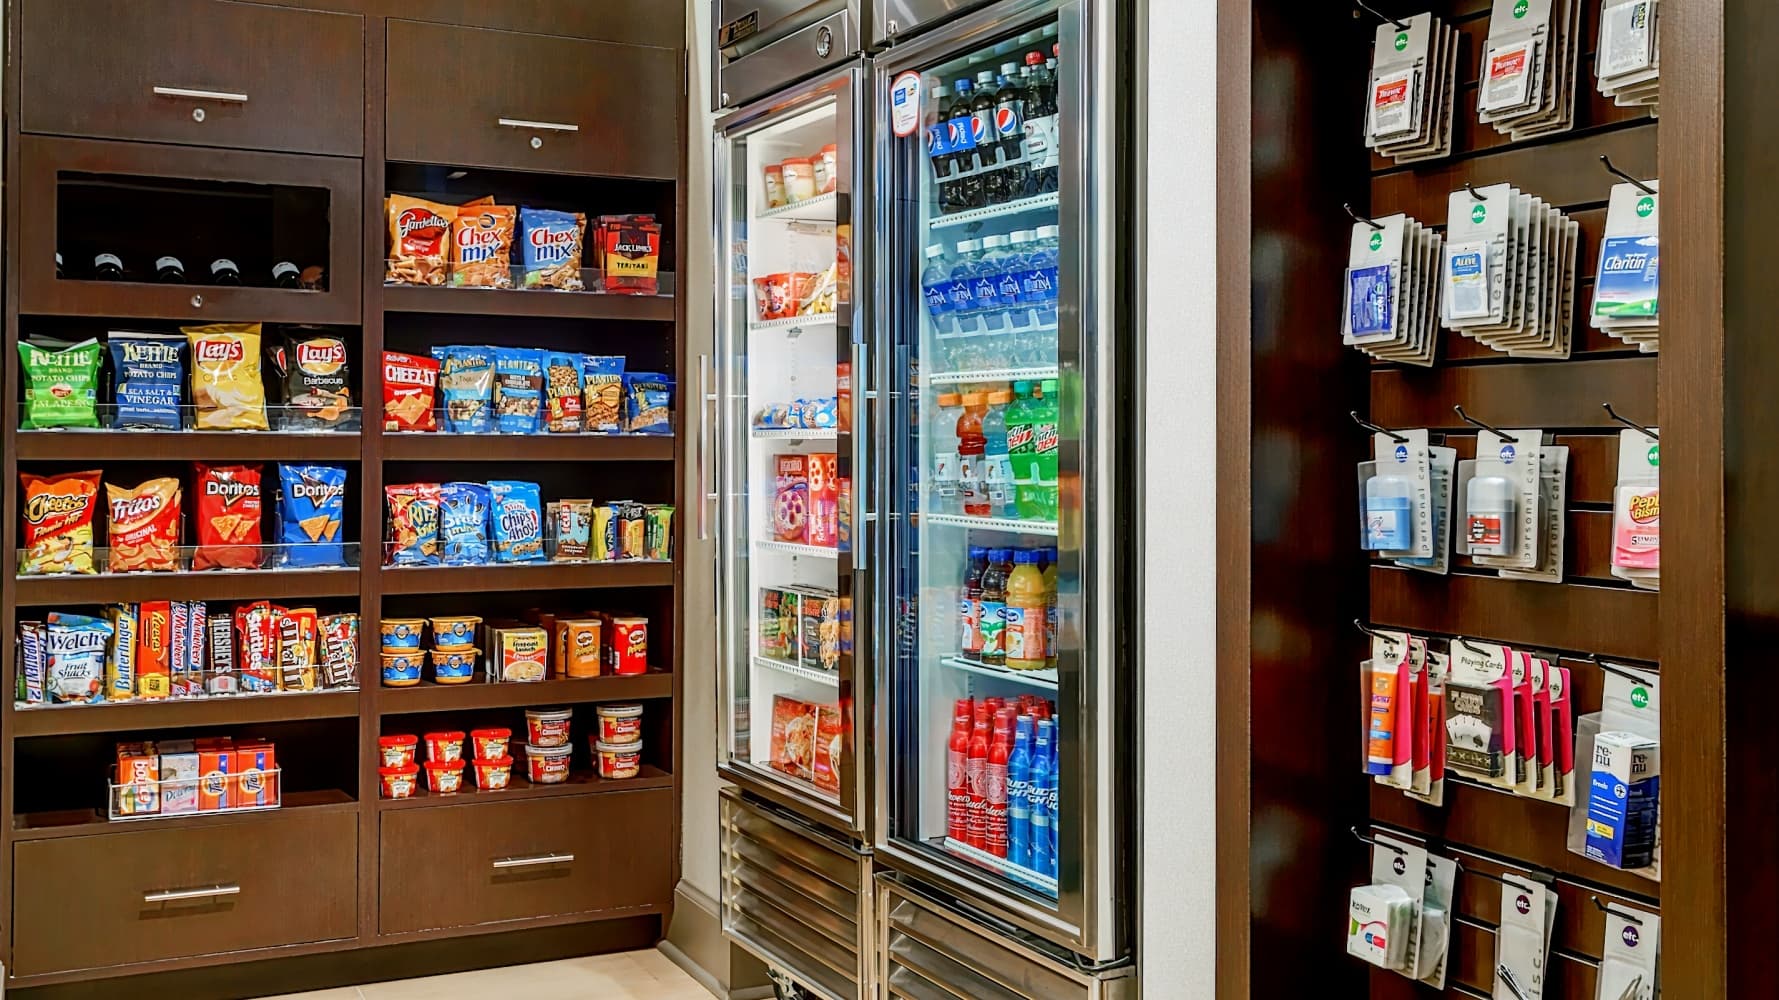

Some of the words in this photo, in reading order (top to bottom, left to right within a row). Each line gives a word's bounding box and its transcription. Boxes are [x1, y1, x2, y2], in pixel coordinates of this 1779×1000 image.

[1637, 202, 1655, 212] etc.
[457, 227, 503, 247] Chex
[530, 228, 577, 246] Chex
[462, 243, 500, 262] mix
[536, 243, 575, 261] mix
[616, 261, 649, 270] TERIYAKI
[1604, 256, 1646, 270] Claritin
[120, 342, 179, 363] KETTLE
[200, 340, 241, 362] Lay's
[301, 341, 342, 363] Lay's
[124, 371, 154, 379] POTATO
[303, 376, 344, 386] Barbecue
[145, 388, 165, 396] SALT
[125, 395, 175, 405] VINEGAR
[206, 481, 260, 496] Doritos
[293, 483, 344, 498] Doritos
[28, 494, 87, 523] Cheetos
[112, 495, 161, 523] Fritos
[502, 511, 532, 531] Chips
[50, 631, 109, 651] Welch's
[1461, 656, 1485, 670] Playing
[1485, 659, 1503, 671] Cards
[1631, 693, 1648, 704] etc.
[1516, 900, 1531, 911] etc.
[1622, 932, 1640, 943] etc.
[1528, 948, 1542, 995] isc.
